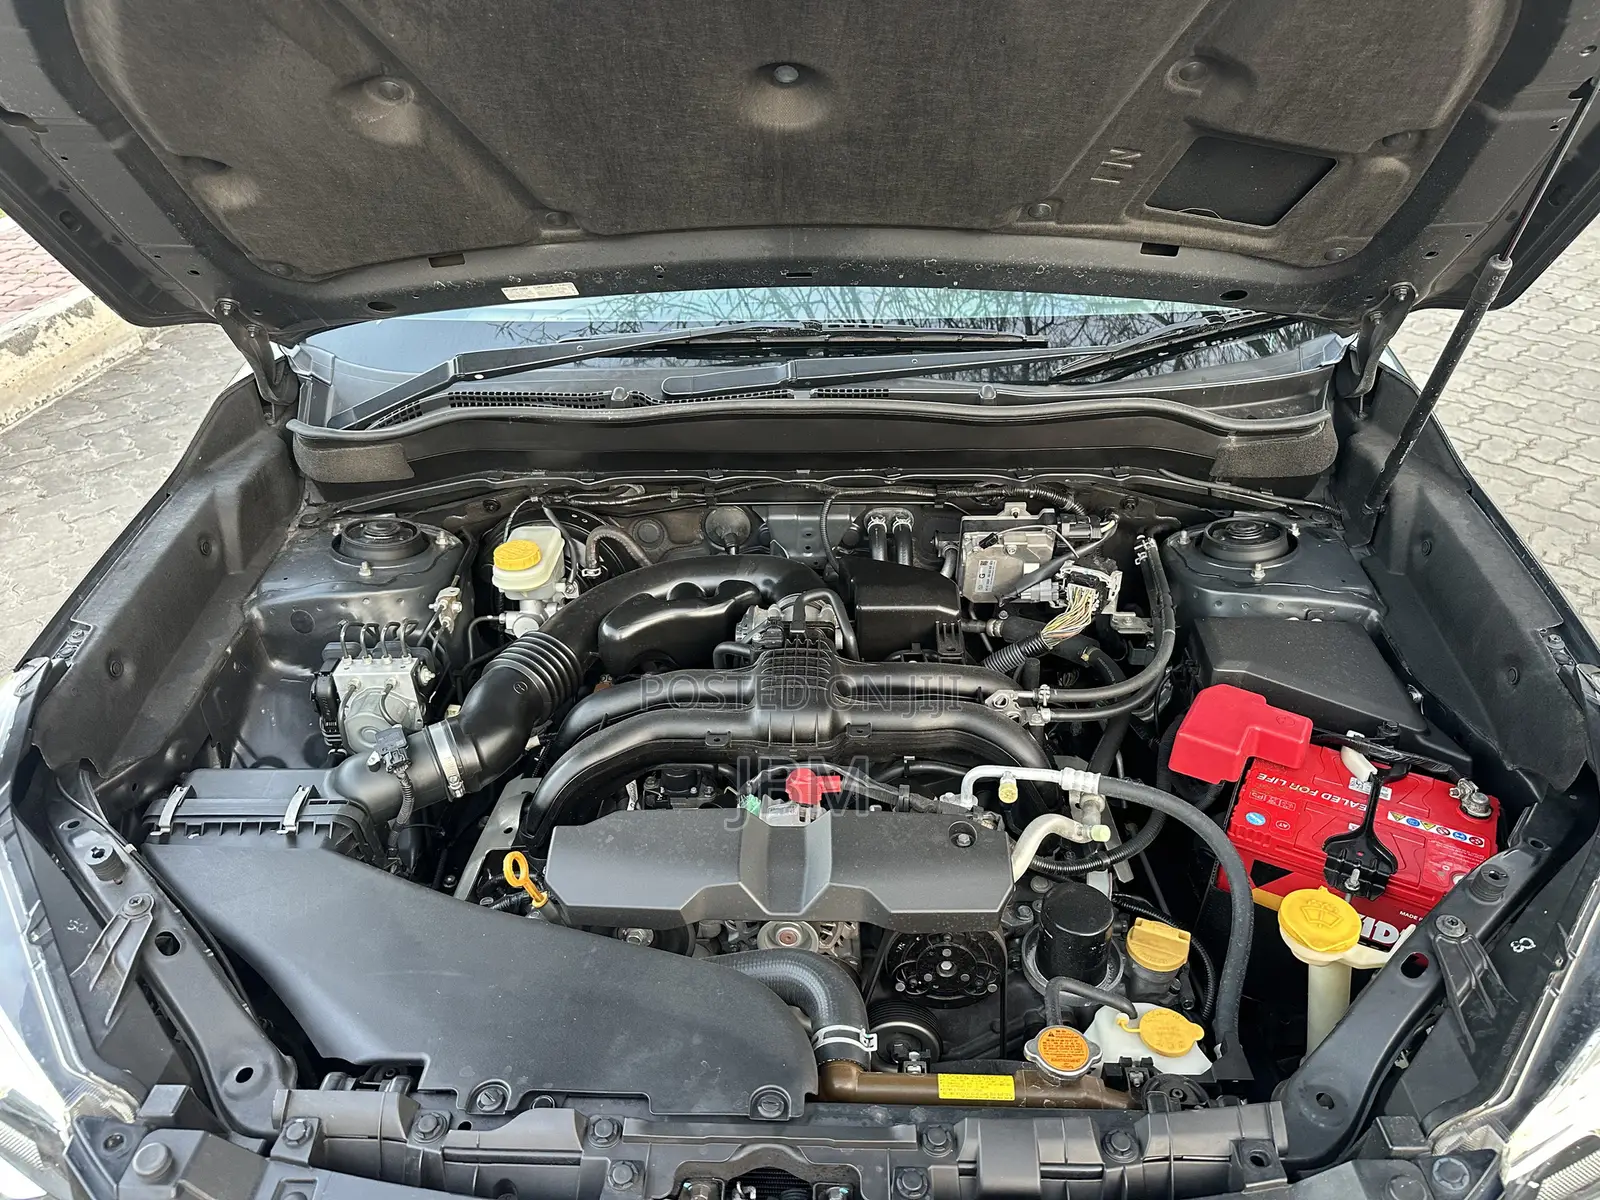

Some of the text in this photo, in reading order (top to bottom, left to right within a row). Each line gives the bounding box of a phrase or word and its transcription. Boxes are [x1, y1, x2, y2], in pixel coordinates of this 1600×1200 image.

[1257, 772, 1368, 811] EALED FOR LIFE
[1399, 910, 1419, 921] MADE
